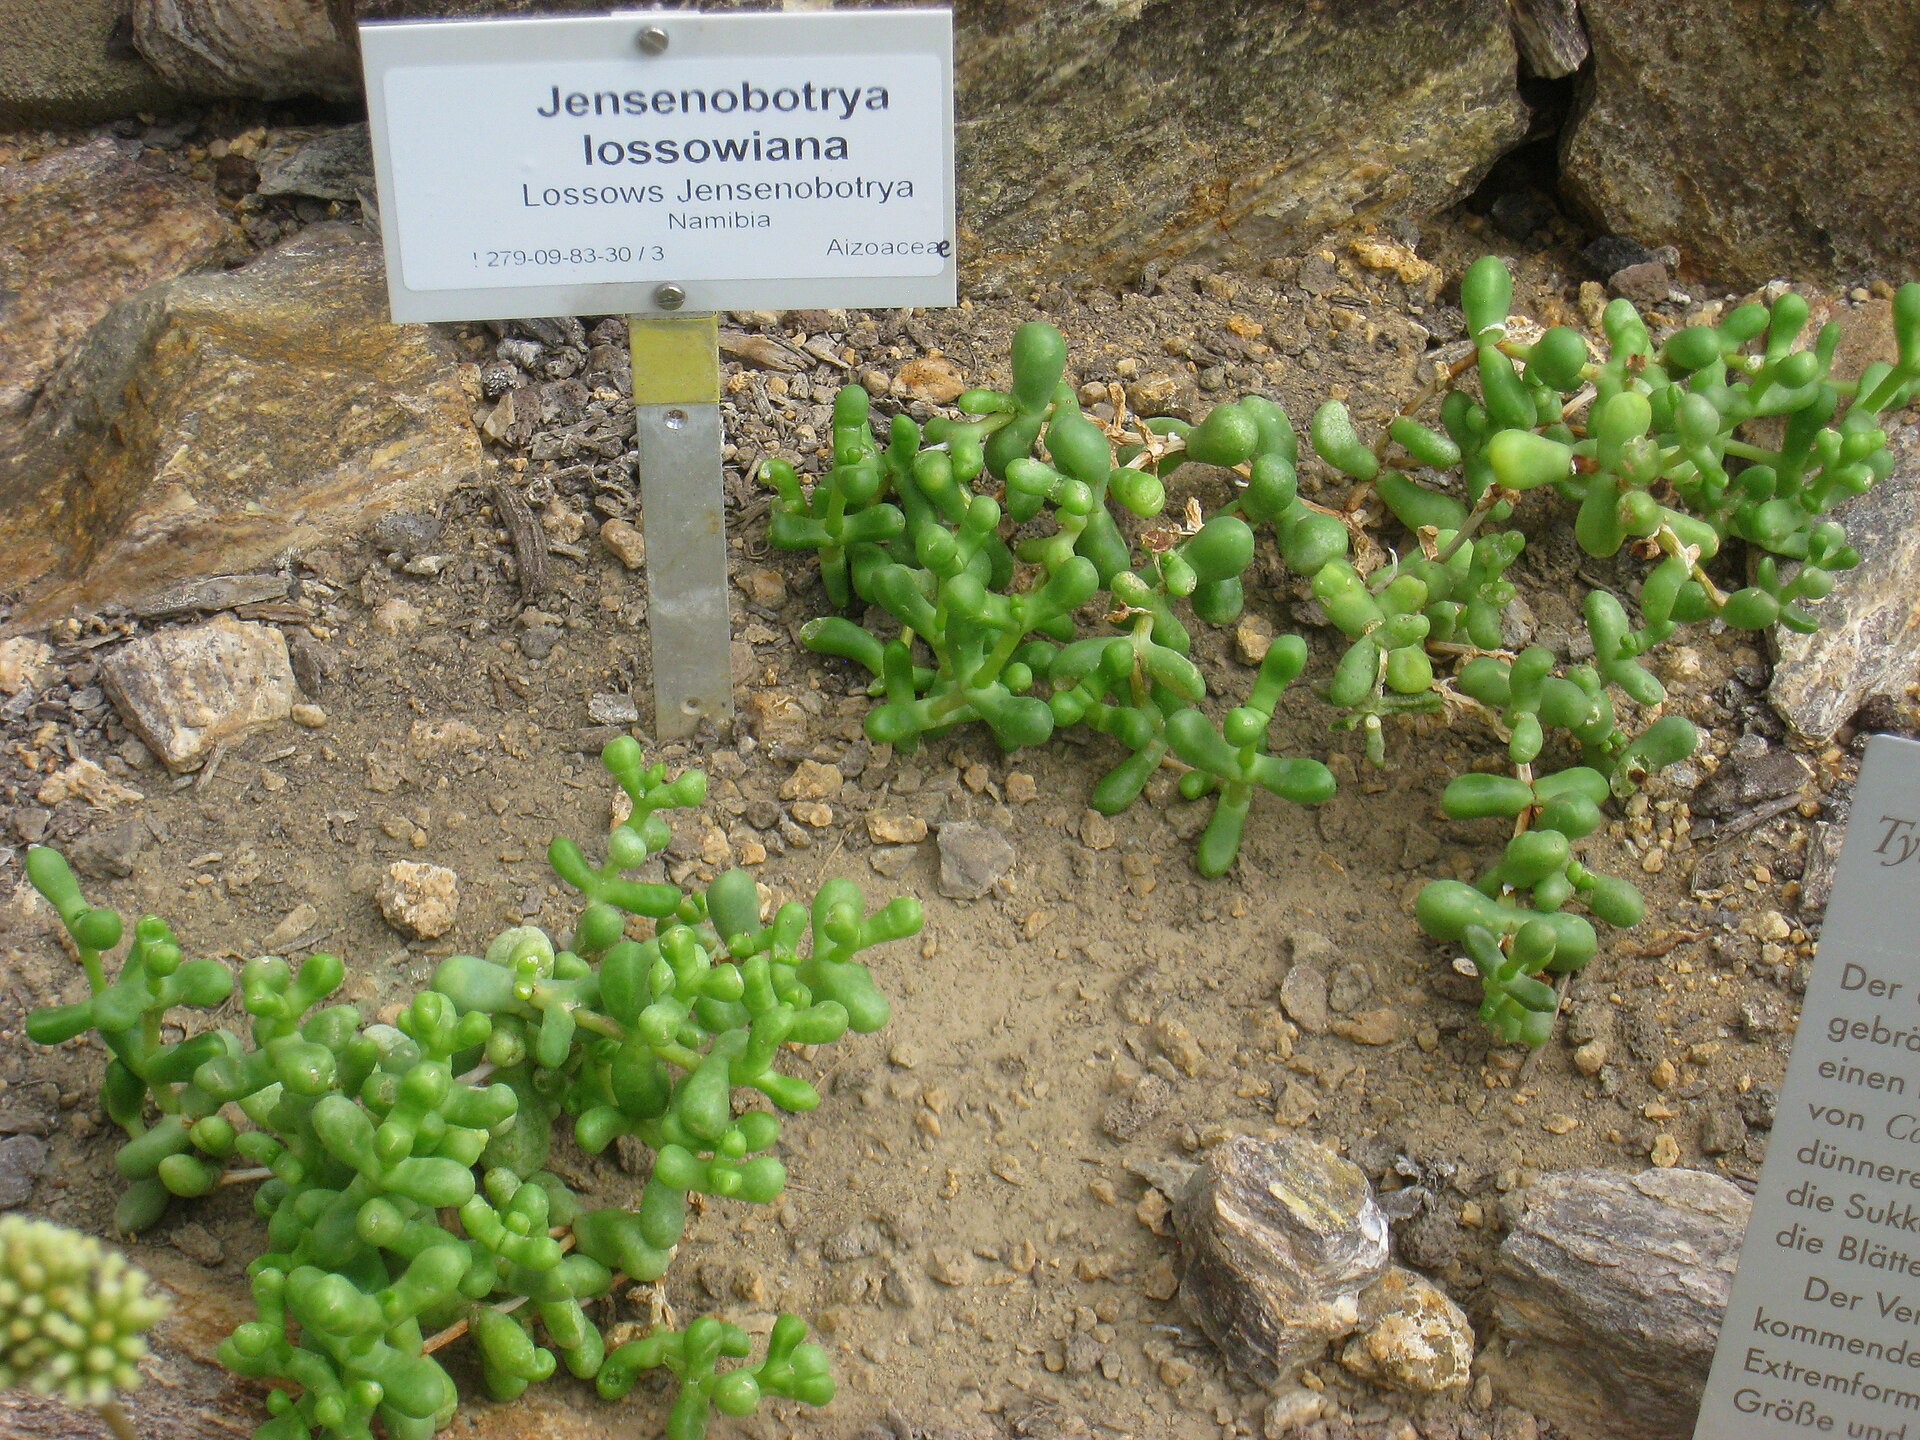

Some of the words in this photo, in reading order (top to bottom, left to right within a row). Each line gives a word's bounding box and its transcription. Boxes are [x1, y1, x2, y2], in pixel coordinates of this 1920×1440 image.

[537, 82, 889, 120] Jensenobotrya
[583, 131, 849, 165] lossowiana
[523, 184, 664, 207] Lossows
[677, 176, 914, 204] Jensenobotrya
[668, 210, 771, 230] Namibia
[486, 246, 632, 267] 279-09-83-30
[651, 246, 665, 261] 3
[826, 238, 952, 258] Aizoaceae
[1873, 815, 1920, 867] Ty
[1840, 963, 1903, 999] Der
[1818, 1056, 1905, 1095] einen
[1808, 1103, 1864, 1131] von
[1797, 1139, 1920, 1189] dünnere
[1786, 1181, 1834, 1212] die
[1844, 1193, 1920, 1232] Sukk
[1776, 1223, 1823, 1254] die
[1838, 1235, 1920, 1277] Blätte
[1804, 1276, 1863, 1310] Der
[1753, 1306, 1920, 1369] kommende
[1744, 1347, 1920, 1411] Extremform
[1734, 1388, 1834, 1431] Größe
